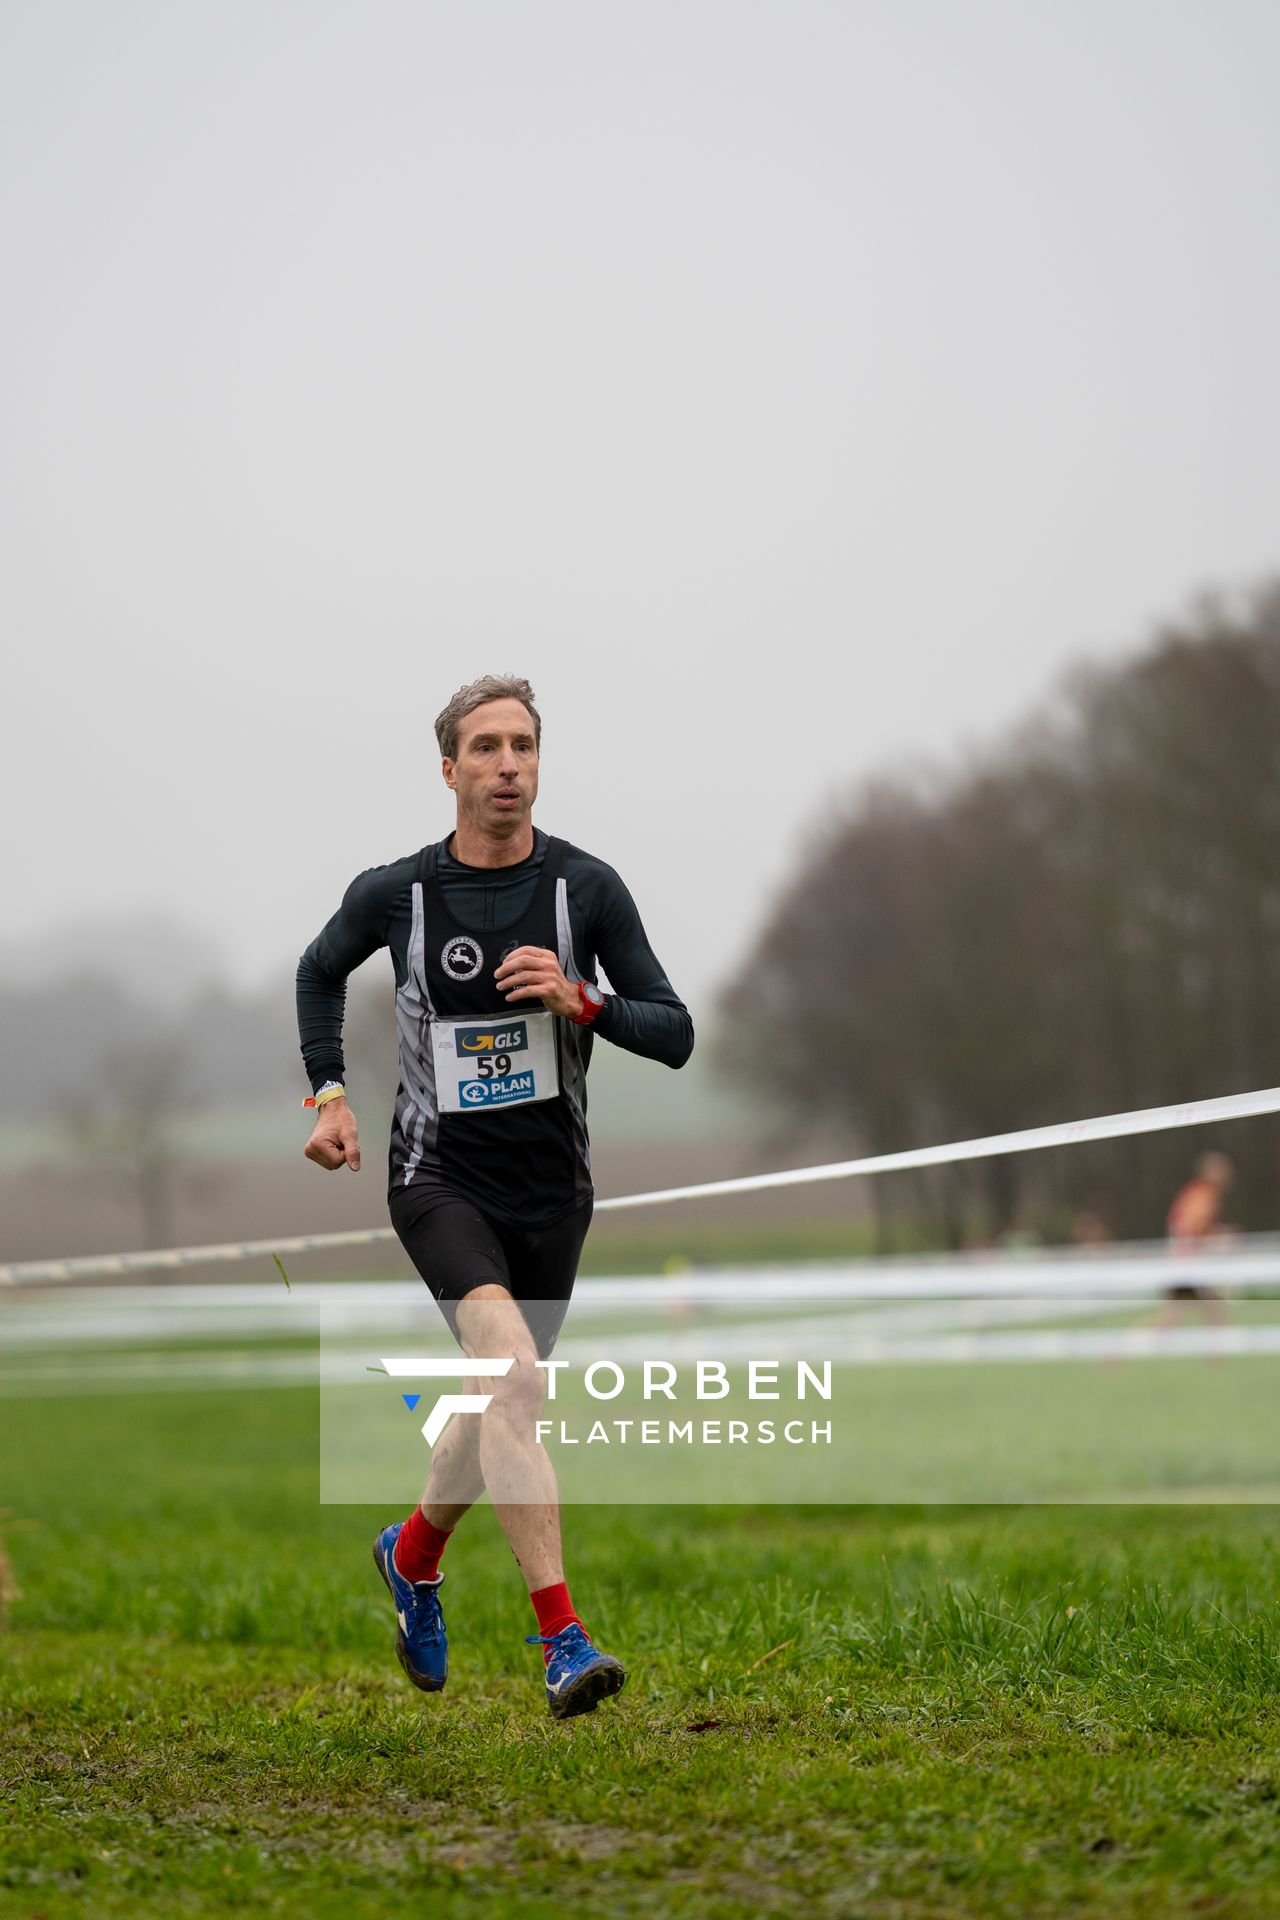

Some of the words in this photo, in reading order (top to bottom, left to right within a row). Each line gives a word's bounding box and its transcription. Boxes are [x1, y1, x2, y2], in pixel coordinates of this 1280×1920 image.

[494, 1030, 521, 1049] GLS
[476, 1054, 512, 1079] 59
[491, 1076, 531, 1095] PLAN
[492, 1090, 531, 1101] INTERNATIONAL
